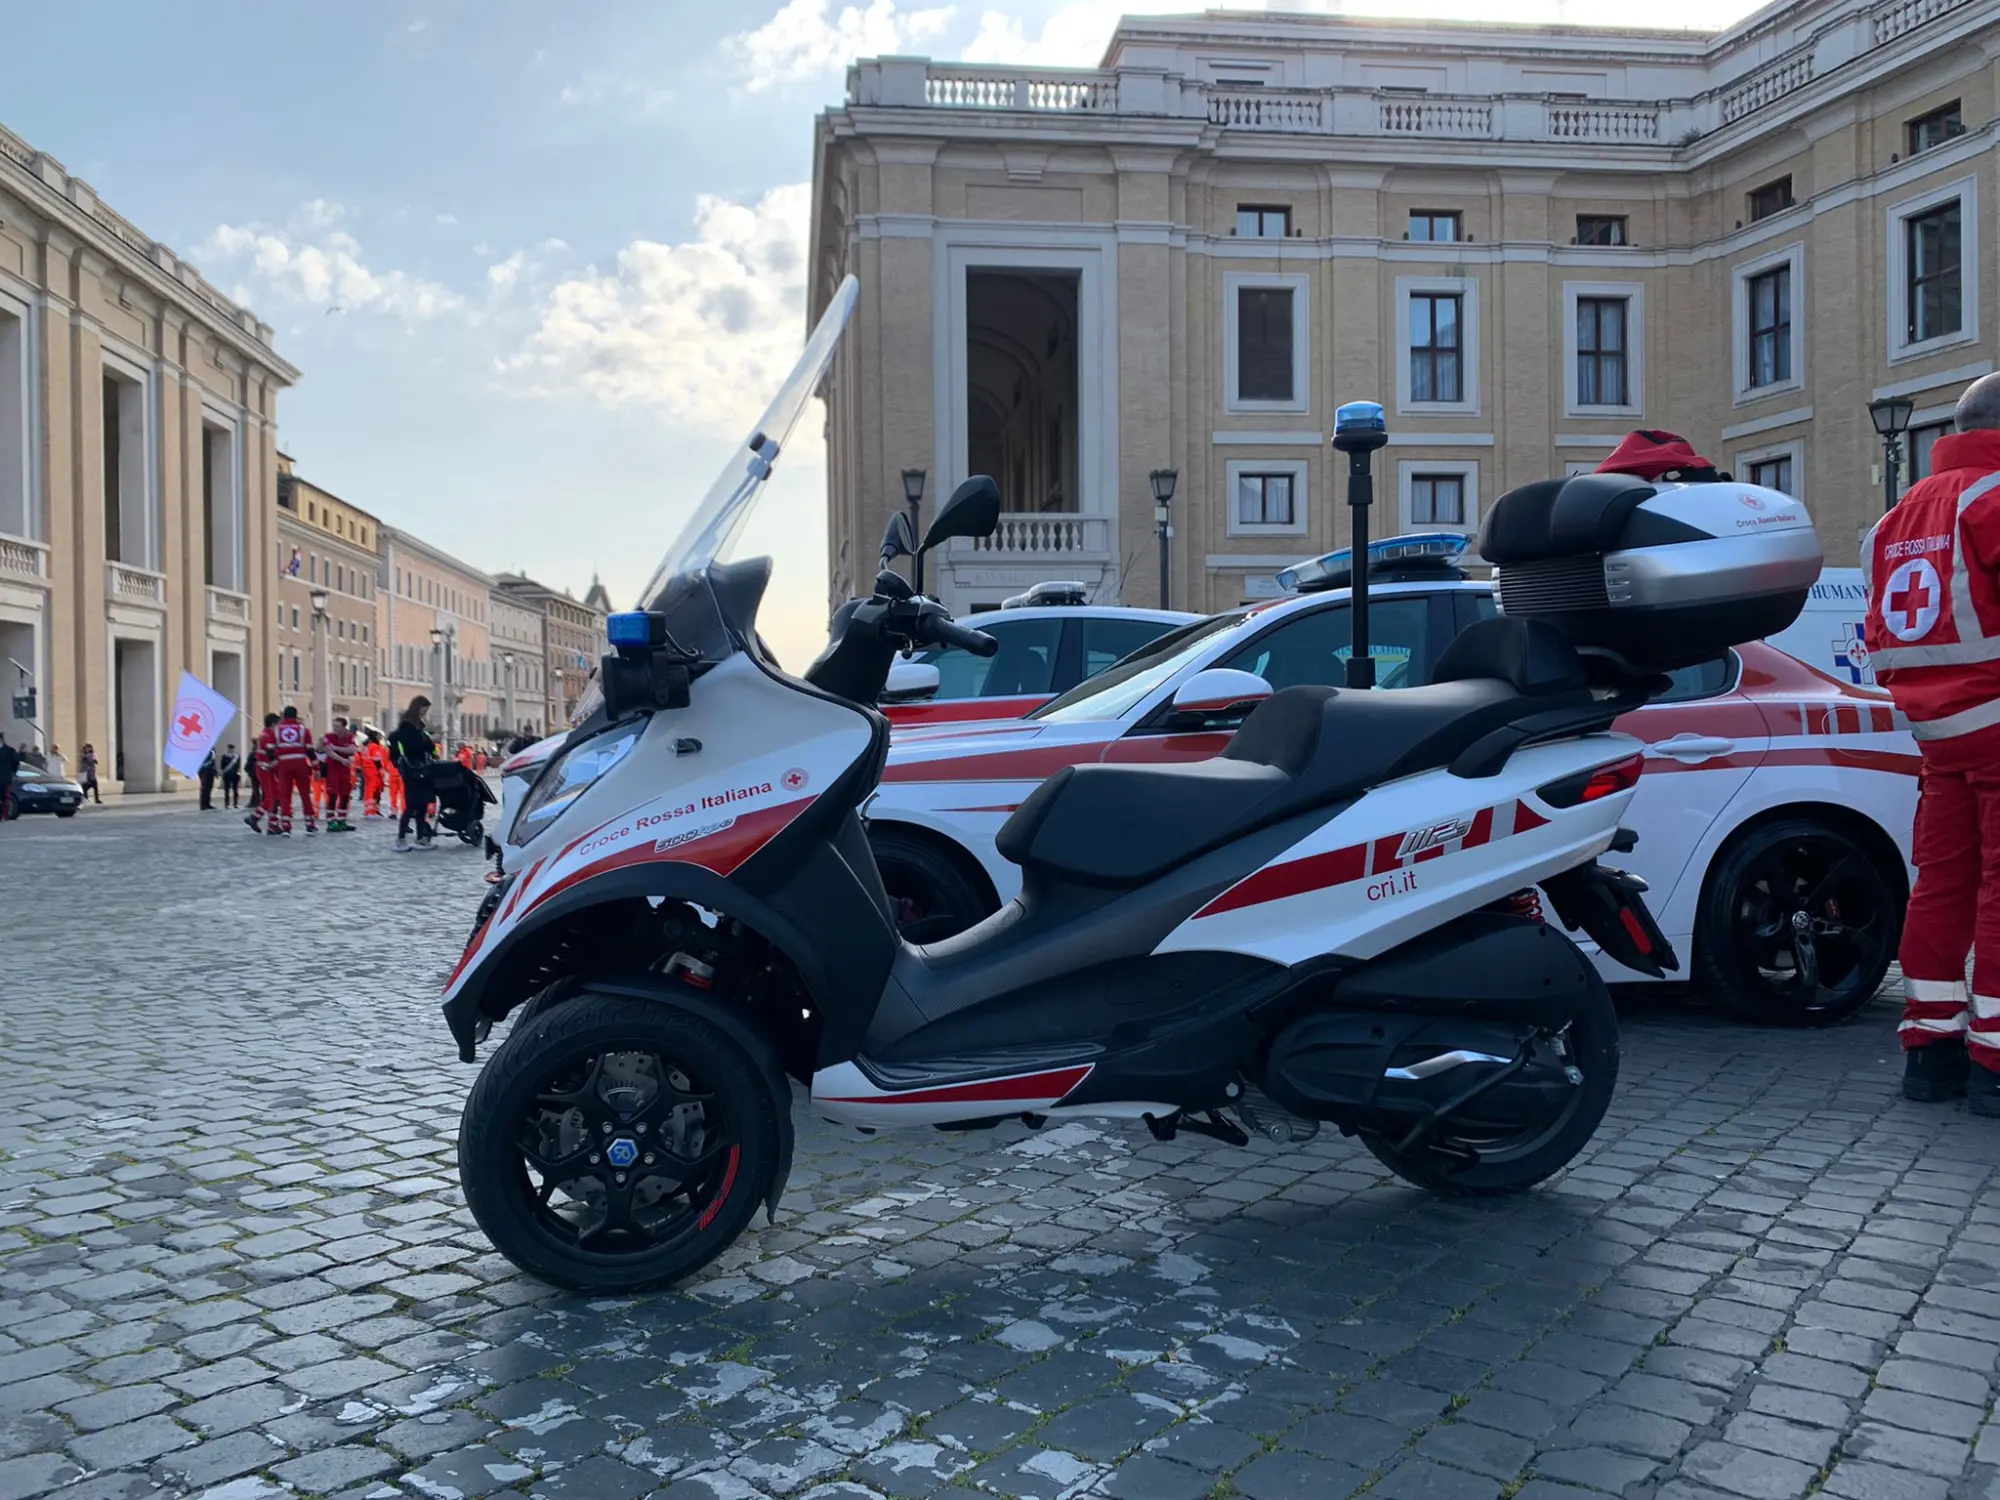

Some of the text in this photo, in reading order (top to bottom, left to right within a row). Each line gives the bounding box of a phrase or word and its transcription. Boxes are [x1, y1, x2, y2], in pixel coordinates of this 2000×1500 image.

[579, 781, 773, 856] Croce Rossa Italiana
[1366, 870, 1418, 901] cri.it
